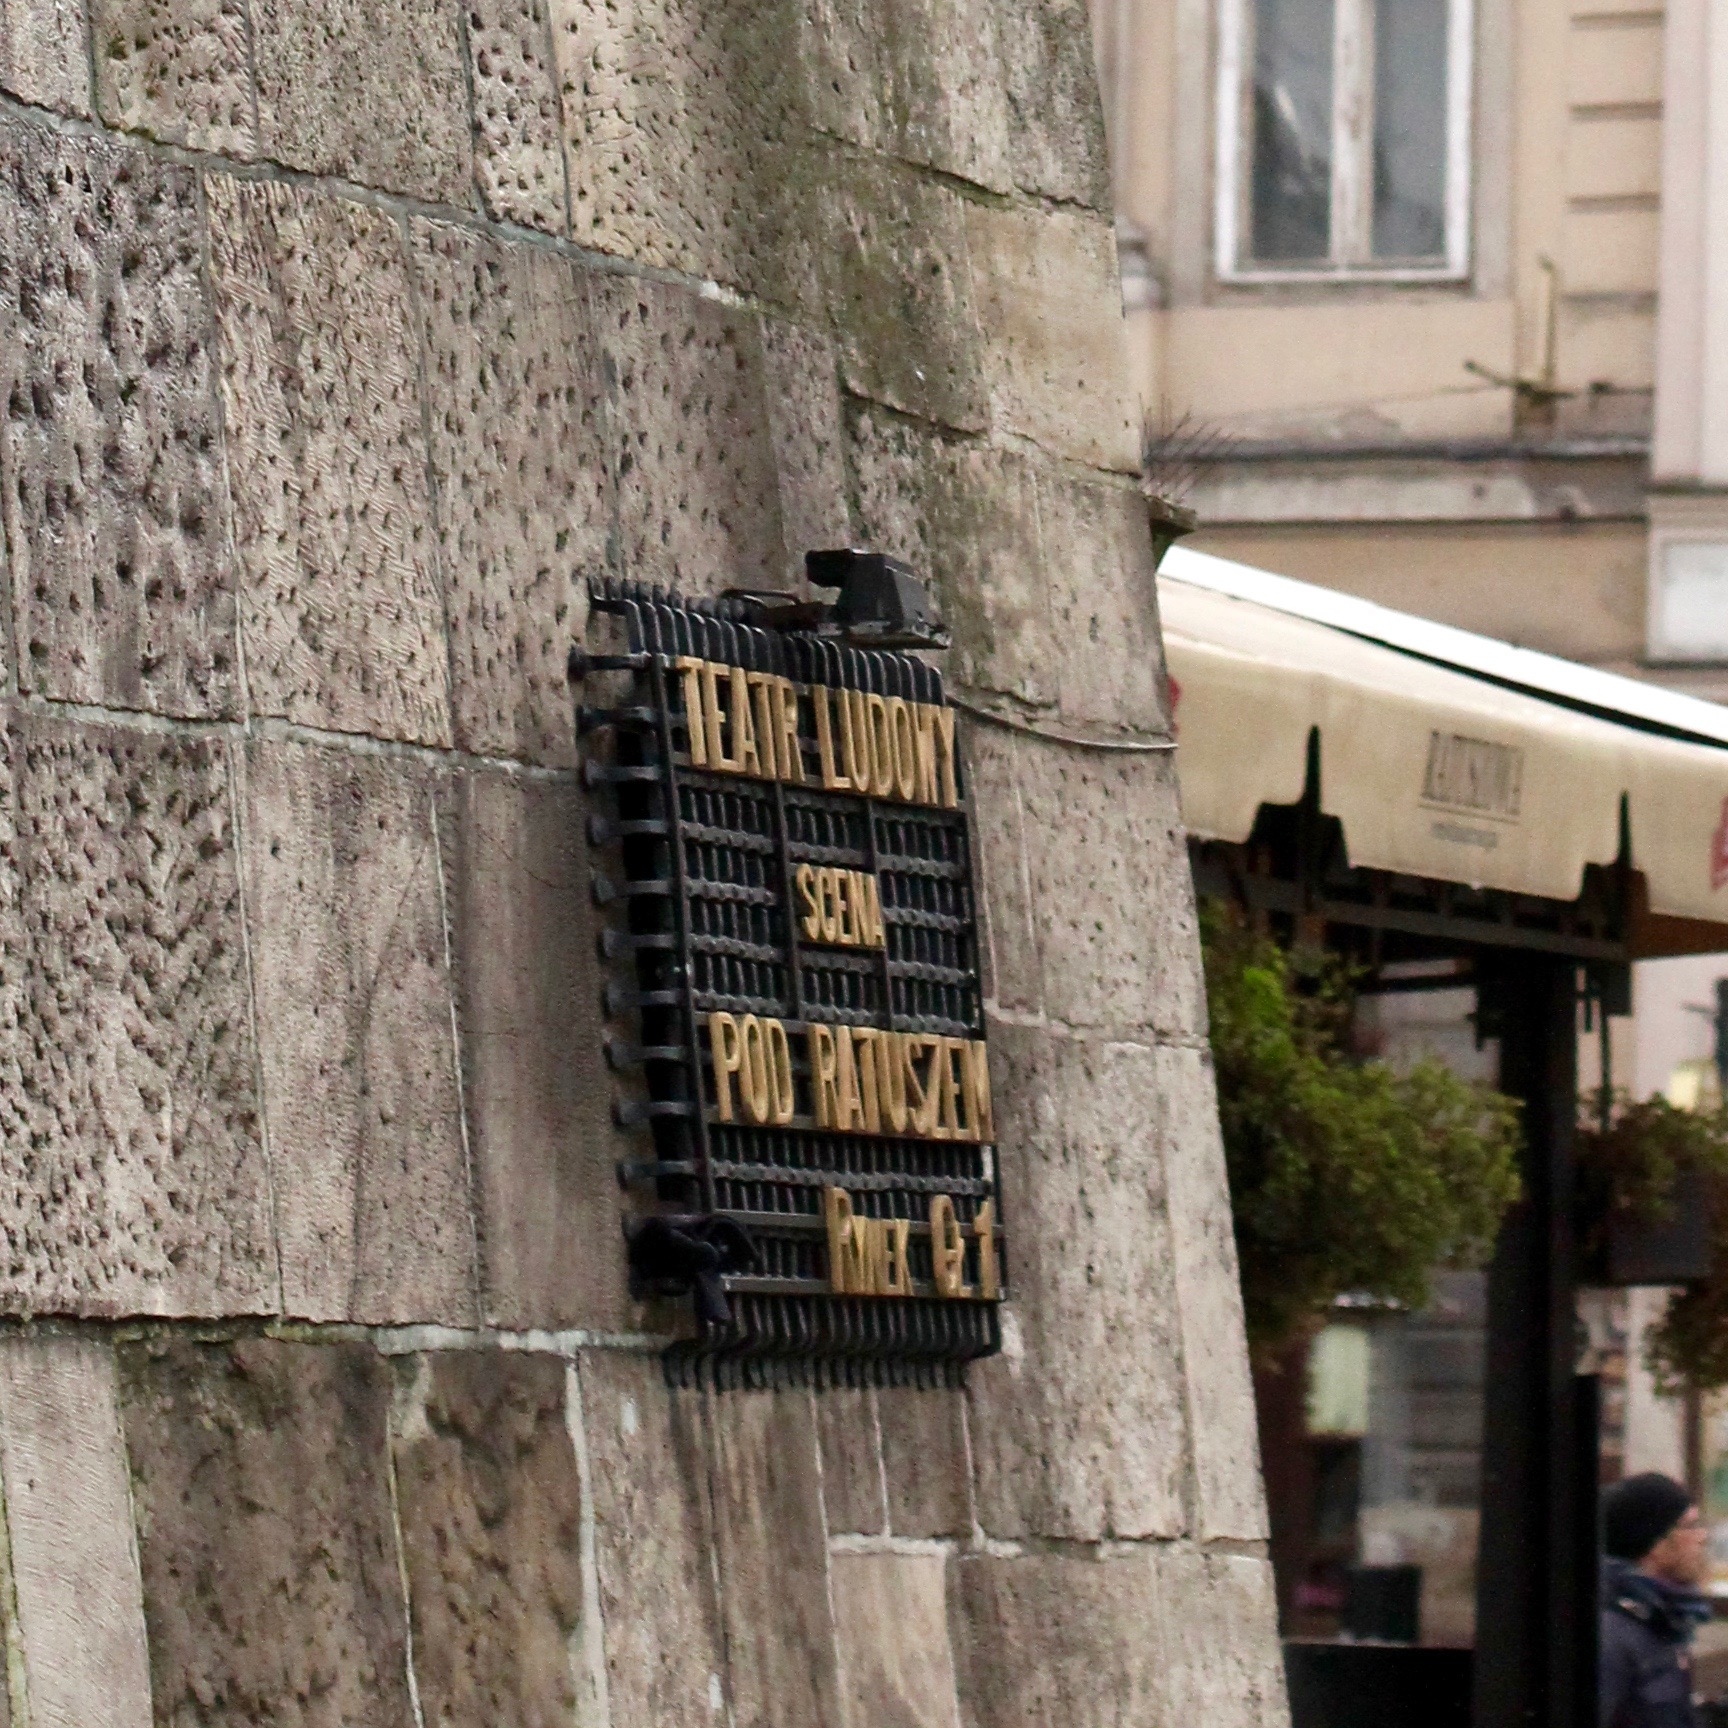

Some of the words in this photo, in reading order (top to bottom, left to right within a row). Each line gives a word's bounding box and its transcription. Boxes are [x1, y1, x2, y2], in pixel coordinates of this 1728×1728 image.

[676, 655, 806, 783] TEATR
[812, 684, 957, 808] LUDOWY
[796, 863, 886, 947] SCENA
[709, 1011, 794, 1125] POD
[807, 1023, 995, 1142] RATUSZEM
